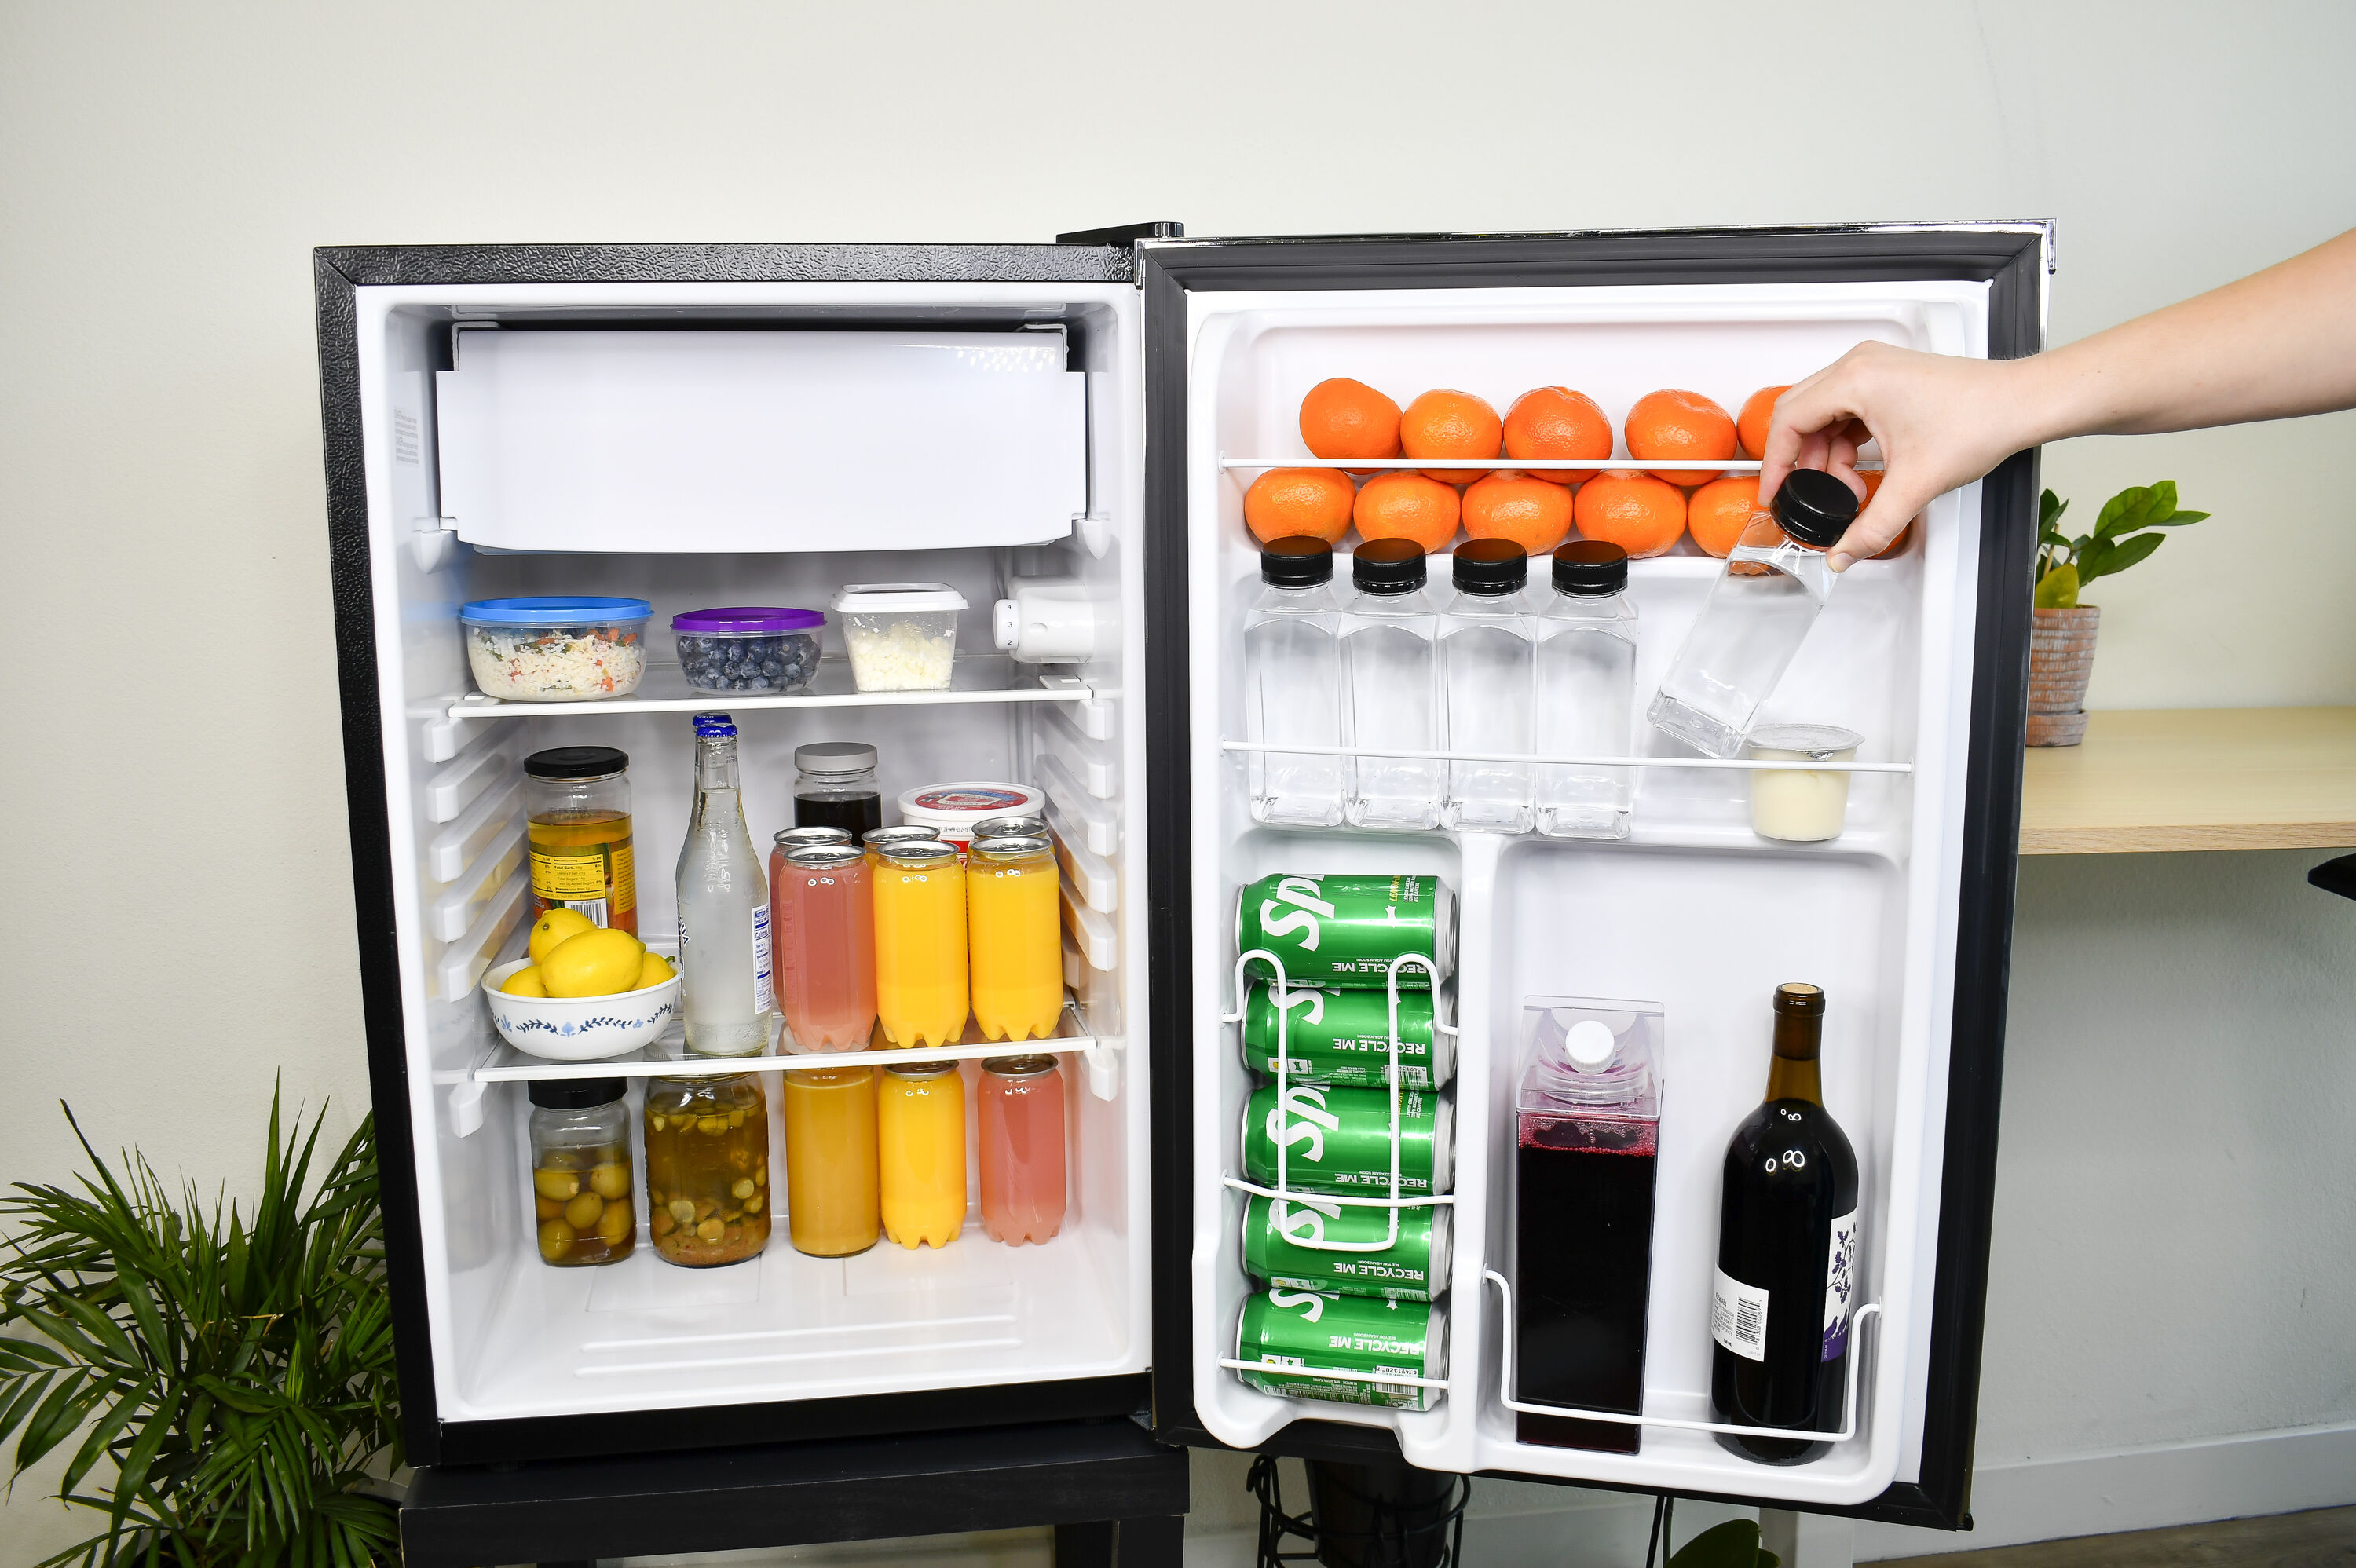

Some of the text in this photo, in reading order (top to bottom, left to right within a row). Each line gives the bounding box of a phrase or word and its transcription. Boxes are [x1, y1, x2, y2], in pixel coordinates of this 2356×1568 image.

[1332, 963, 1427, 974] RECCLE ME
[1333, 1038, 1425, 1054] RECCLE ME
[1335, 1174, 1427, 1188] RECCLE ME
[1333, 1263, 1424, 1280] RECYCLE ME
[1329, 1335, 1420, 1355] RECYCLE ME
